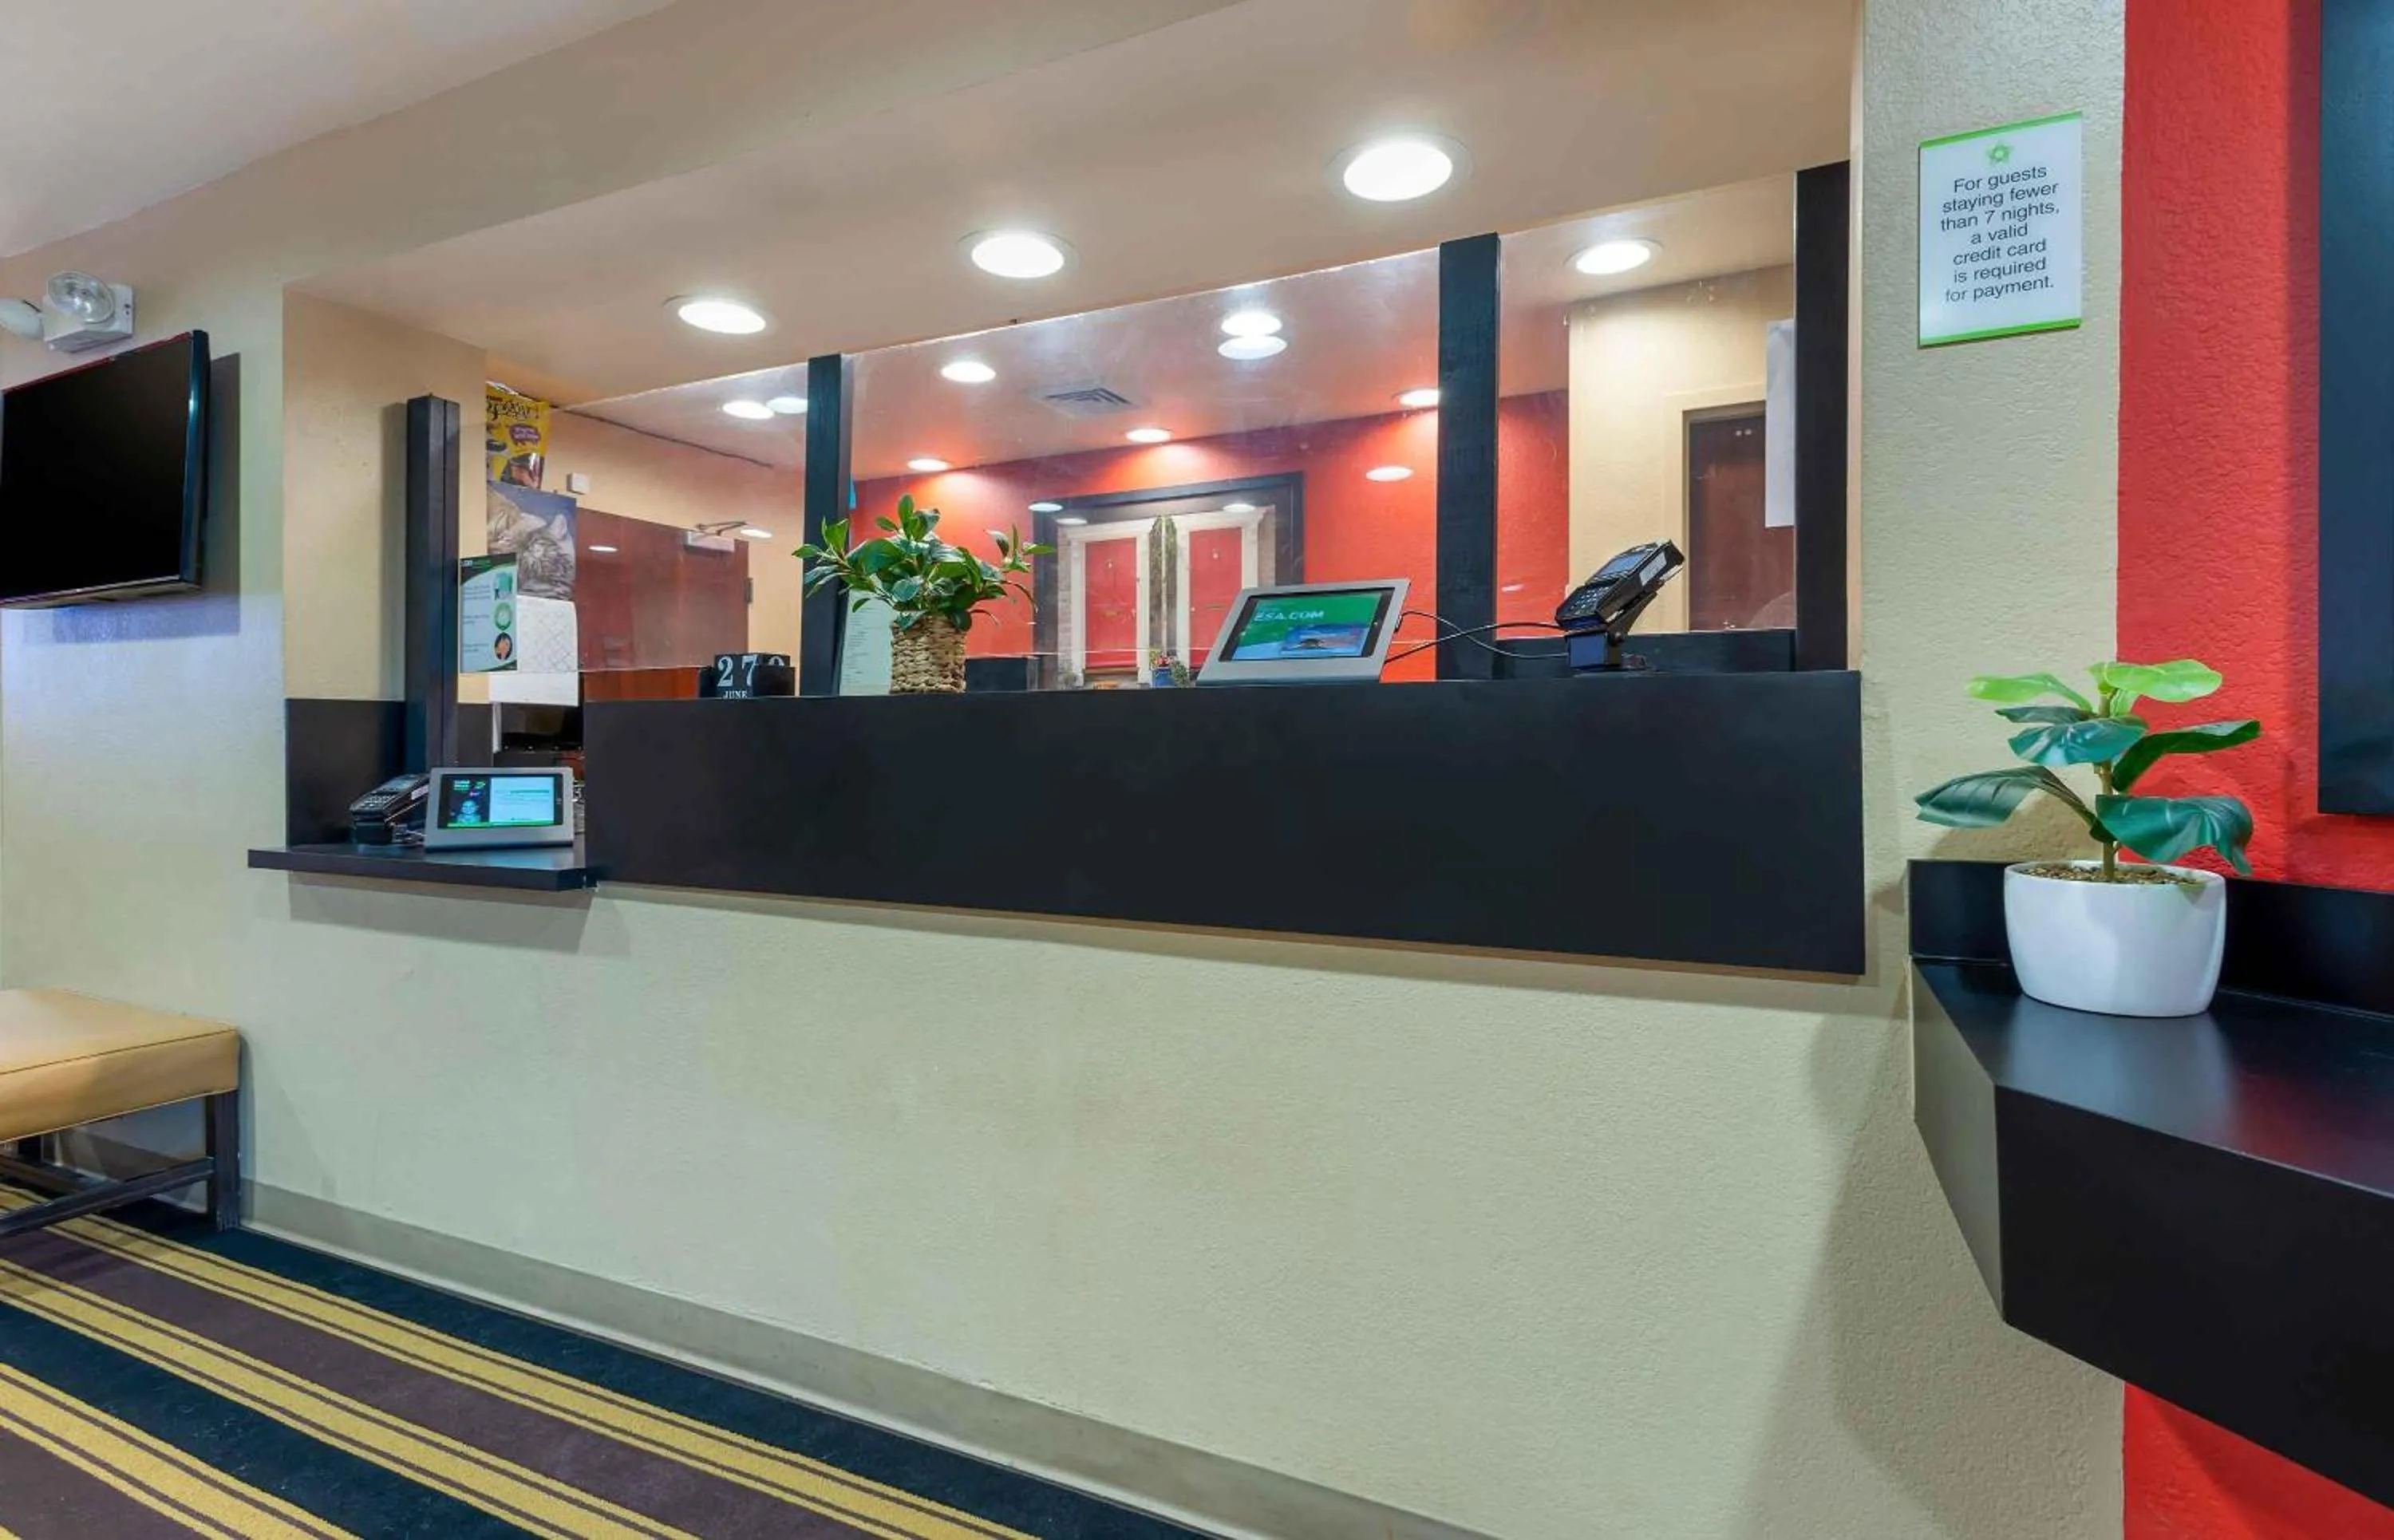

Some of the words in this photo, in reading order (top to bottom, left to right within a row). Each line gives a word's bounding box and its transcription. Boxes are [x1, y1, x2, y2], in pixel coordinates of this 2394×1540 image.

[1954, 178, 1982, 192] For
[1988, 166, 2047, 188] guests
[1942, 192, 2004, 213] staying
[2010, 183, 2060, 200] fewer
[1941, 215, 1977, 231] than
[1985, 210, 1995, 224] 7
[2001, 201, 2060, 222] nights,
[1970, 233, 1981, 244] a
[1989, 223, 2028, 240] valid
[1954, 247, 2001, 266] credit
[2007, 238, 2046, 256] card
[1954, 270, 1967, 283] is
[1973, 257, 2046, 280] required
[1946, 289, 1968, 302] for
[1973, 275, 2054, 302] payment.
[1254, 610, 1325, 622] ESA.COM
[723, 690, 748, 700] JUNE
